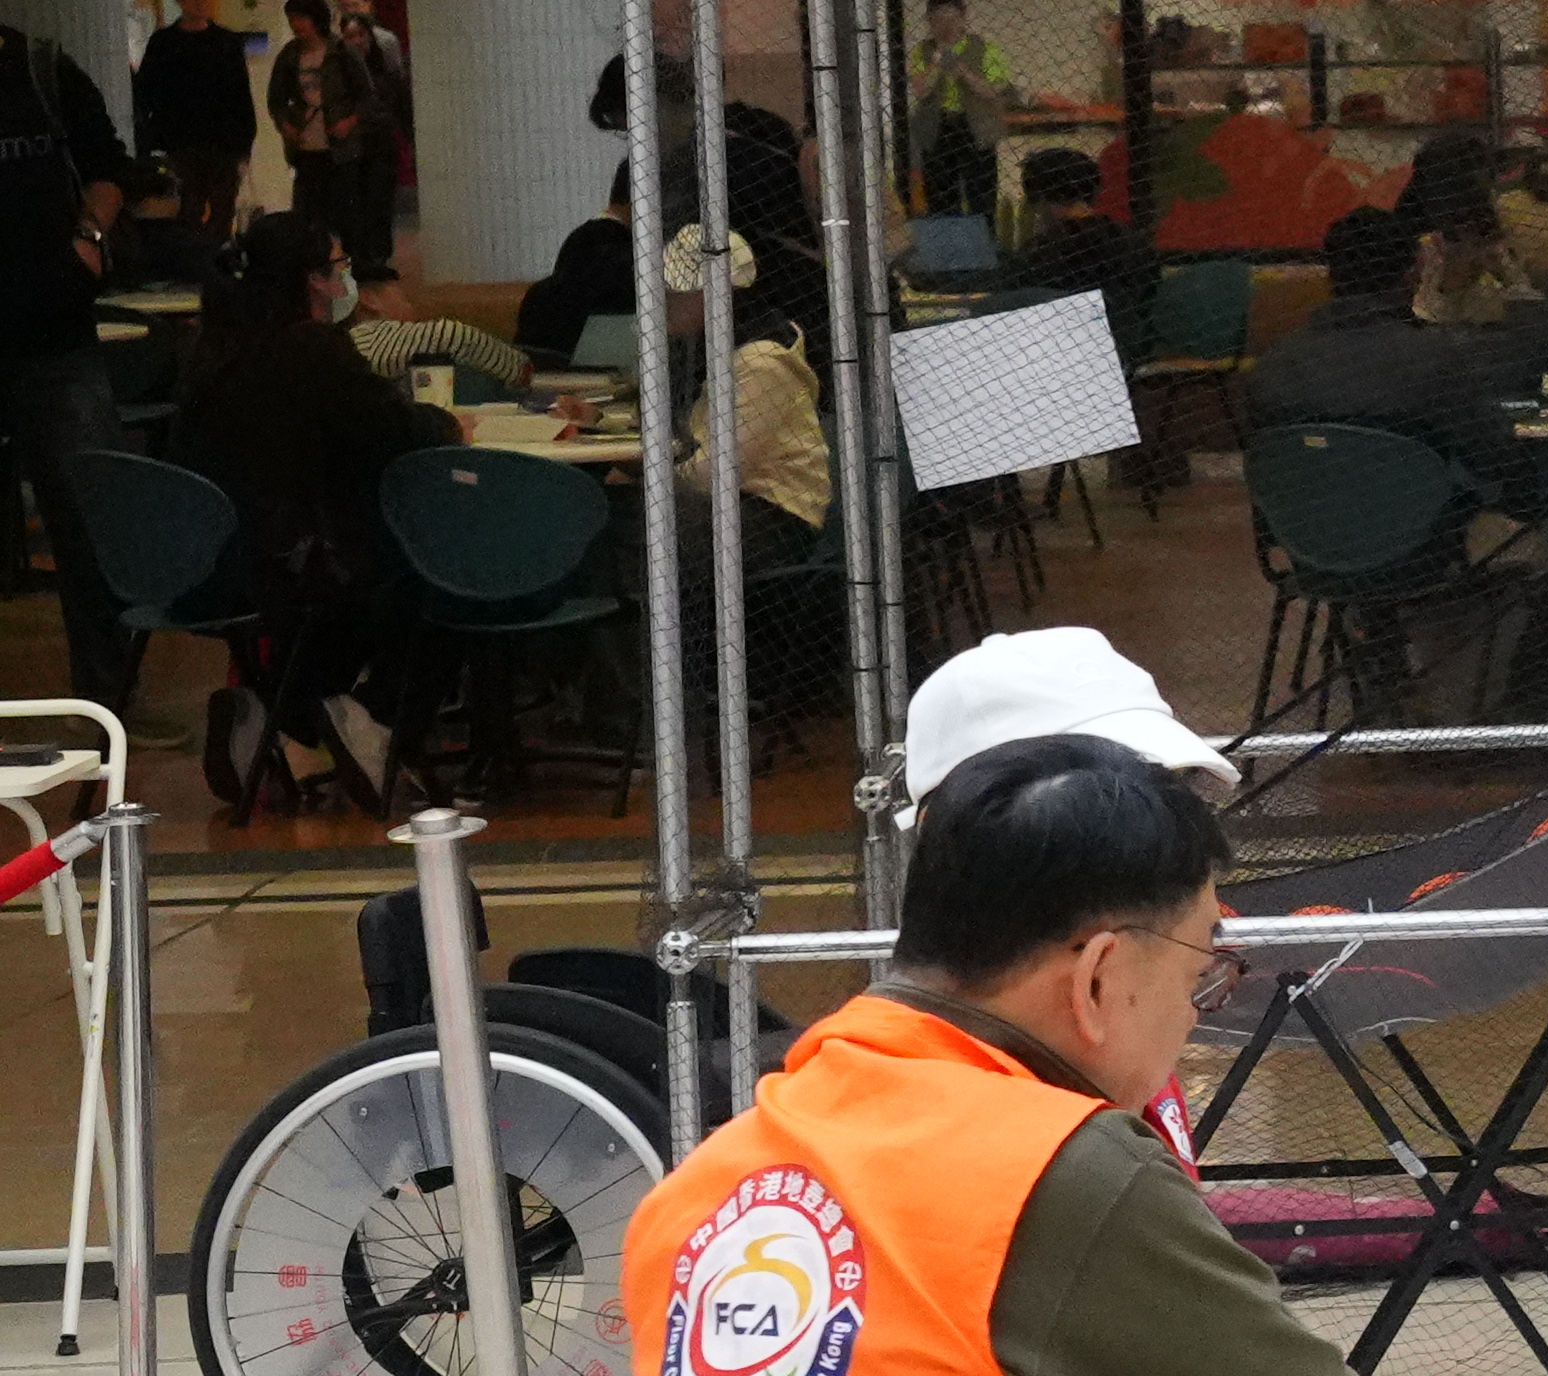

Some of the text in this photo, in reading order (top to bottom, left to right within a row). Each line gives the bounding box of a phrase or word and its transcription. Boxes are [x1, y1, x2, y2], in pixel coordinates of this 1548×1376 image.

[689, 1170, 856, 1258] 中國香港地壺總會
[713, 1302, 780, 1337] FCA
[818, 1320, 853, 1372] Kong
